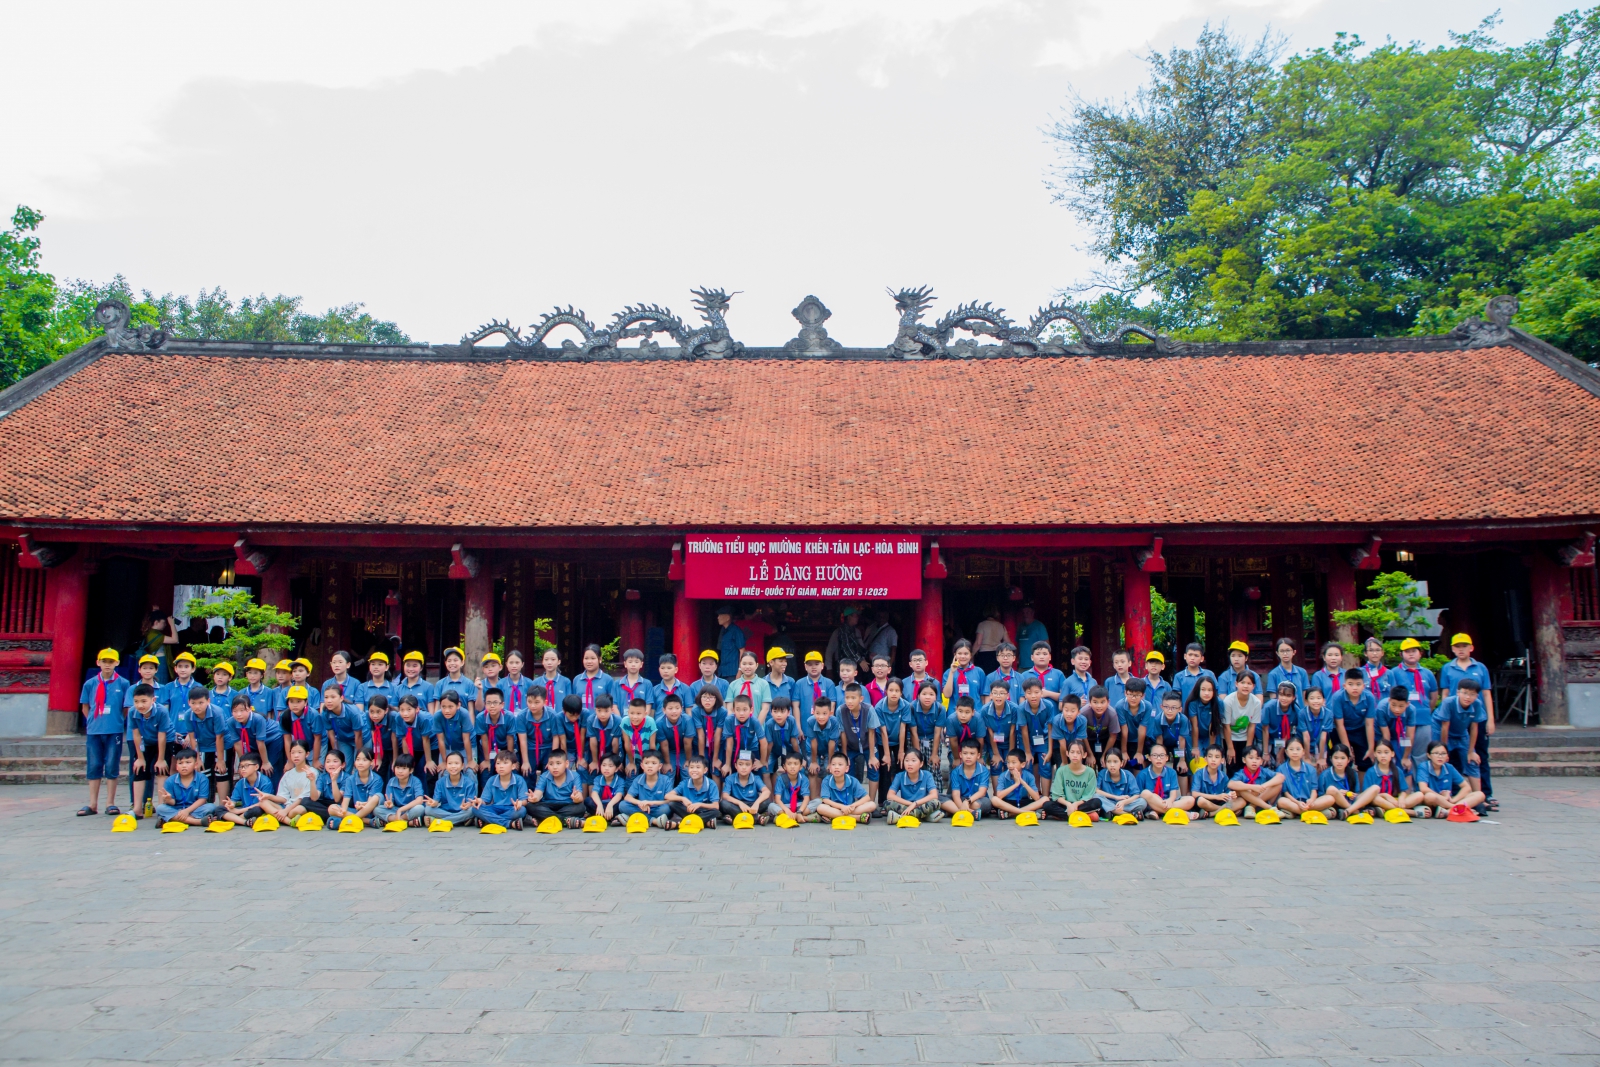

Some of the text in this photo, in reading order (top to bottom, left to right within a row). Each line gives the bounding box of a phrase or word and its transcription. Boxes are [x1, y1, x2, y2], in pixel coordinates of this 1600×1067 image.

[687, 537, 724, 554] TRƯỜNG
[725, 535, 745, 554] TIỂU
[747, 541, 766, 556] HỌC
[768, 537, 802, 554] MƯỜNG
[896, 538, 919, 554] BÌNH
[749, 559, 863, 581] LỄ DÂNG HƯƠNG
[724, 585, 739, 596] VĂN
[785, 584, 797, 596] TỬ
[821, 585, 841, 596] NGÀY
[1065, 779, 1087, 789] ROMA
